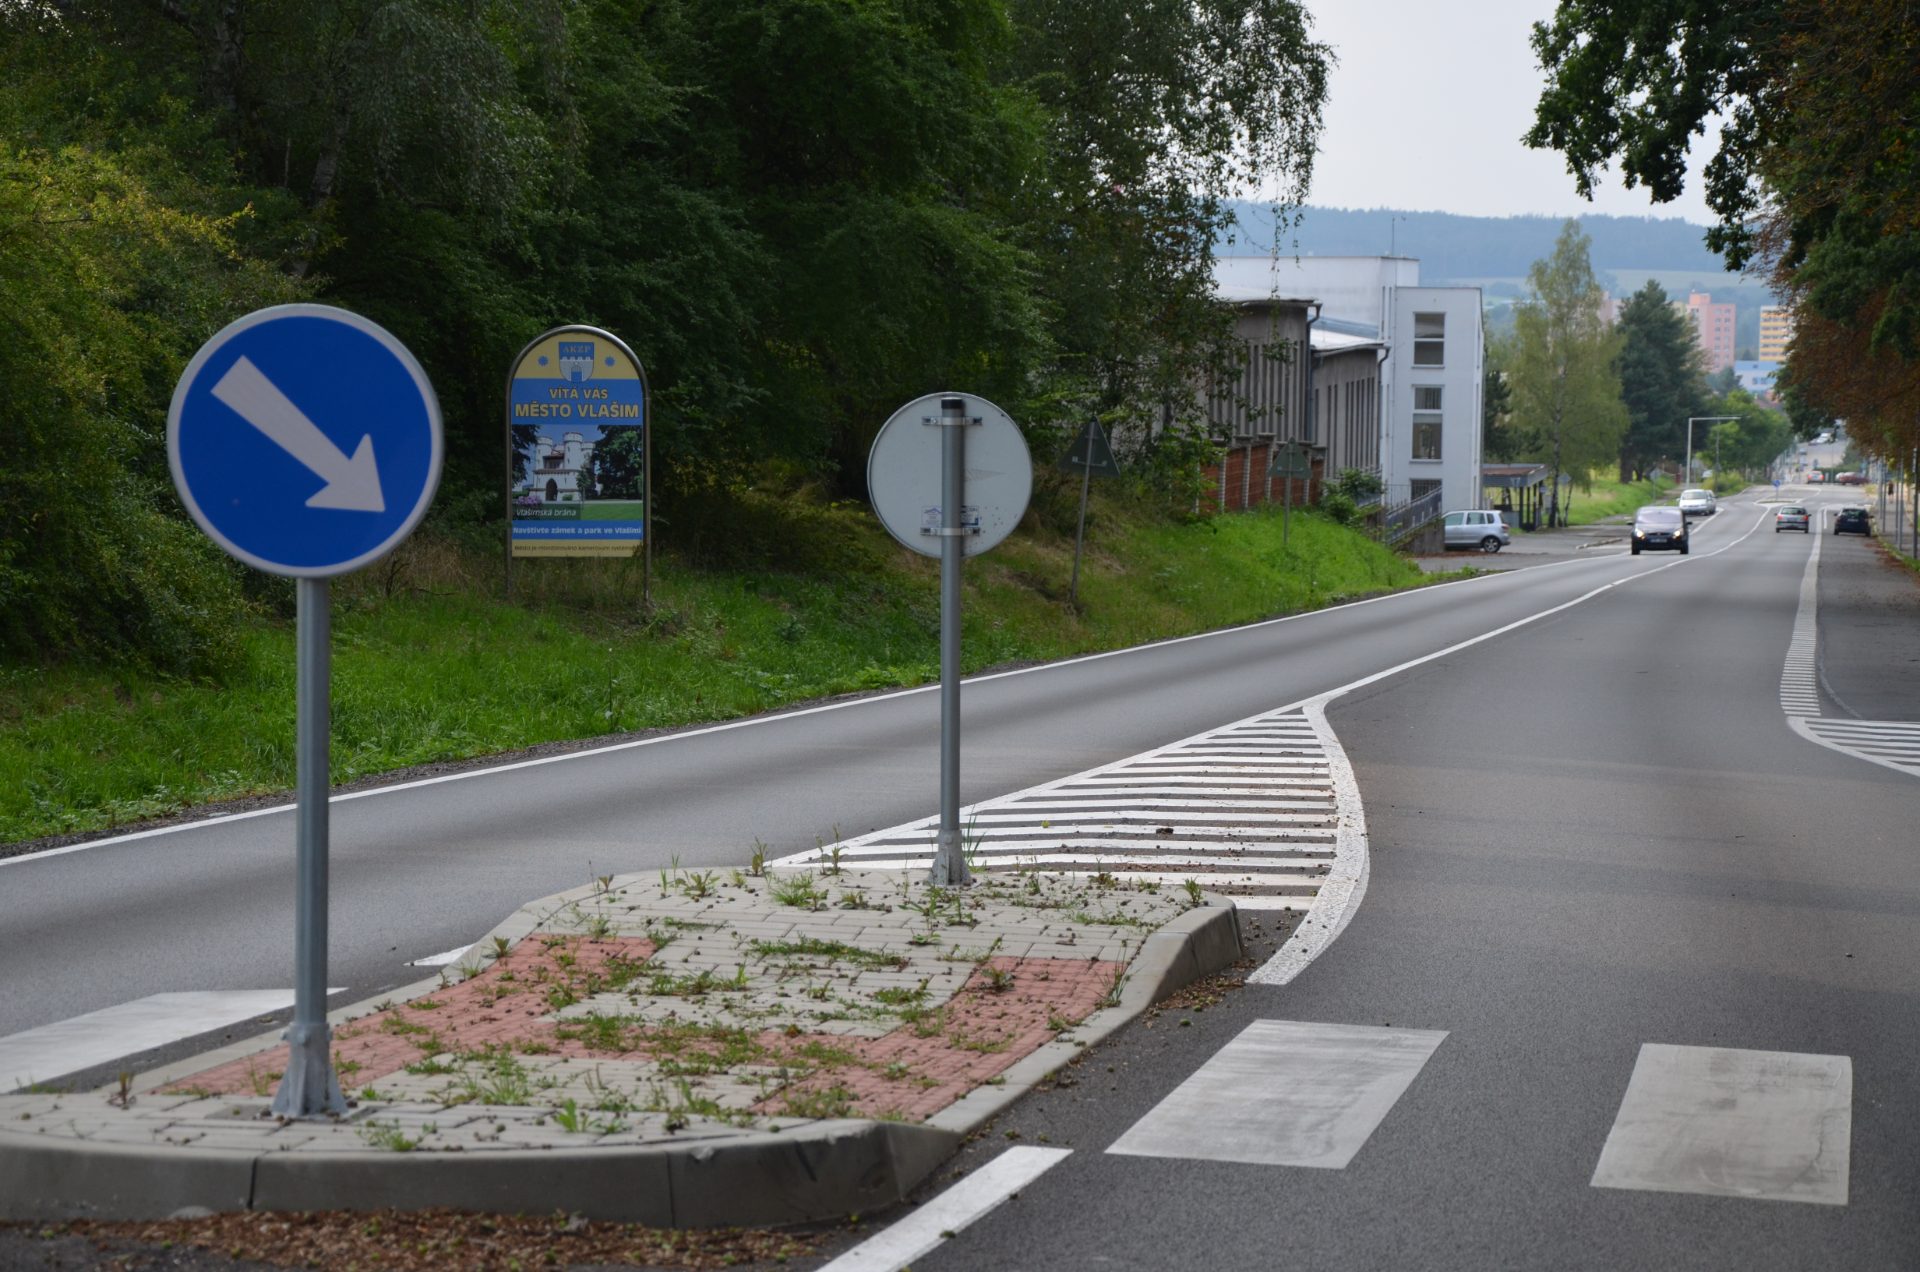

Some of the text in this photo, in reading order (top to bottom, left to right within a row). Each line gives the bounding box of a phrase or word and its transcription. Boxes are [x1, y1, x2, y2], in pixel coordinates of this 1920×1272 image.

[549, 386, 608, 399] VÍTÁ VÁS
[515, 401, 639, 418] MĚSTO VLAŠIM
[584, 527, 602, 535] park
